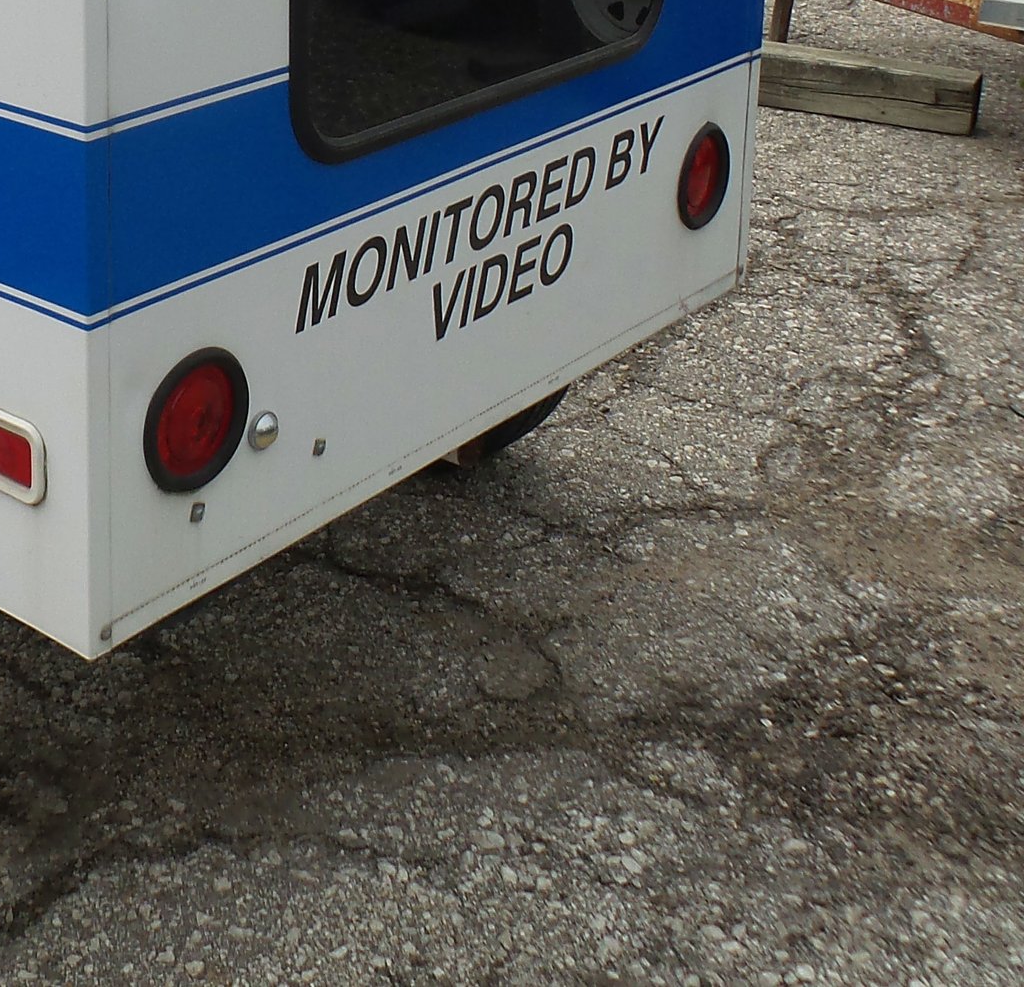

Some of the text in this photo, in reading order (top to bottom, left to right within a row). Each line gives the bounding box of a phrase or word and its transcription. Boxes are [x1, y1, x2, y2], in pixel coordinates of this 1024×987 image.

[294, 114, 666, 334] MONITORED BY
[431, 222, 574, 342] VIDEO
